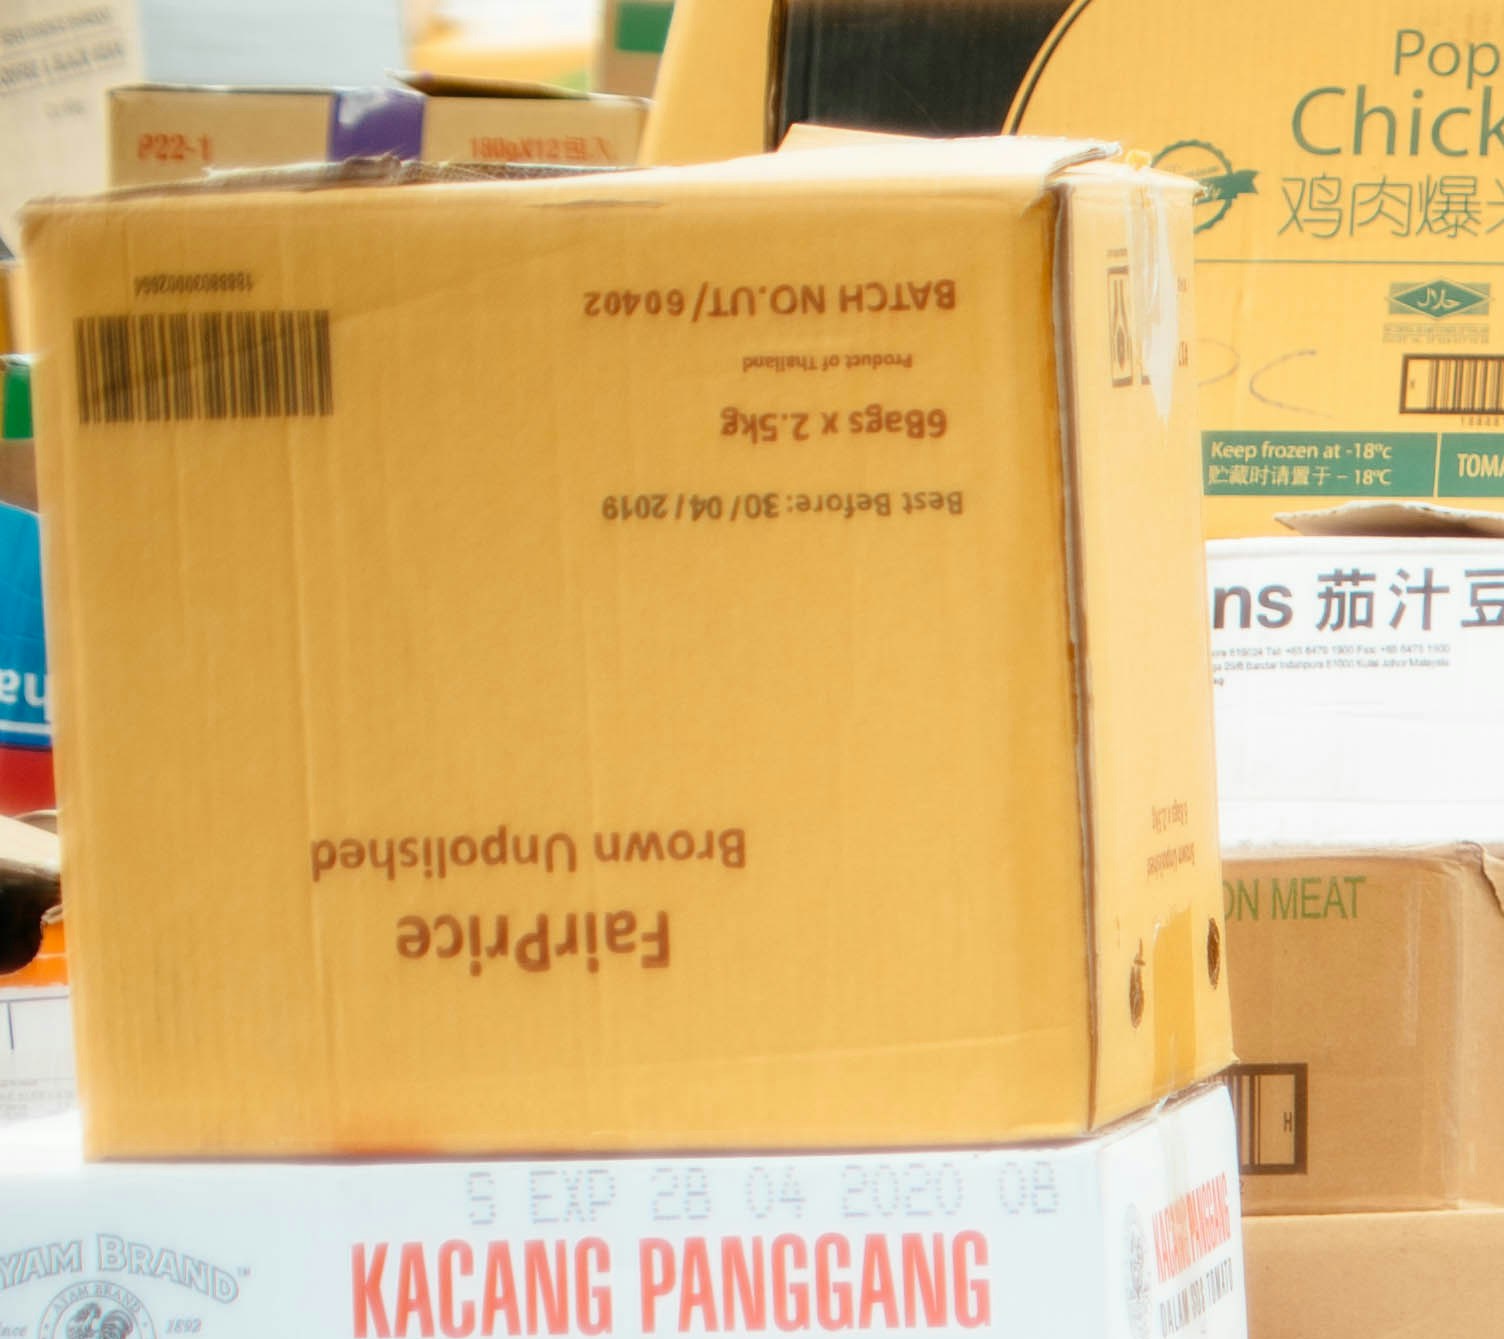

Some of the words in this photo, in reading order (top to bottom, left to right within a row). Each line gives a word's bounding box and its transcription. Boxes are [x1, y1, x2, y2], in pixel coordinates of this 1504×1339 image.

[741, 354, 818, 374] Thailand
[846, 352, 914, 371] Product
[720, 404, 811, 444] 2.5kg
[848, 405, 948, 443] 6Bags
[1261, 441, 1310, 461] frozen
[786, 491, 892, 522] Before:
[900, 489, 965, 519] Best
[309, 824, 577, 881] Unpolished
[593, 827, 748, 872] Brown
[1271, 876, 1368, 921] MEAT
[394, 910, 672, 974] FairPrice
[639, 1228, 992, 1335] PANGGANG
